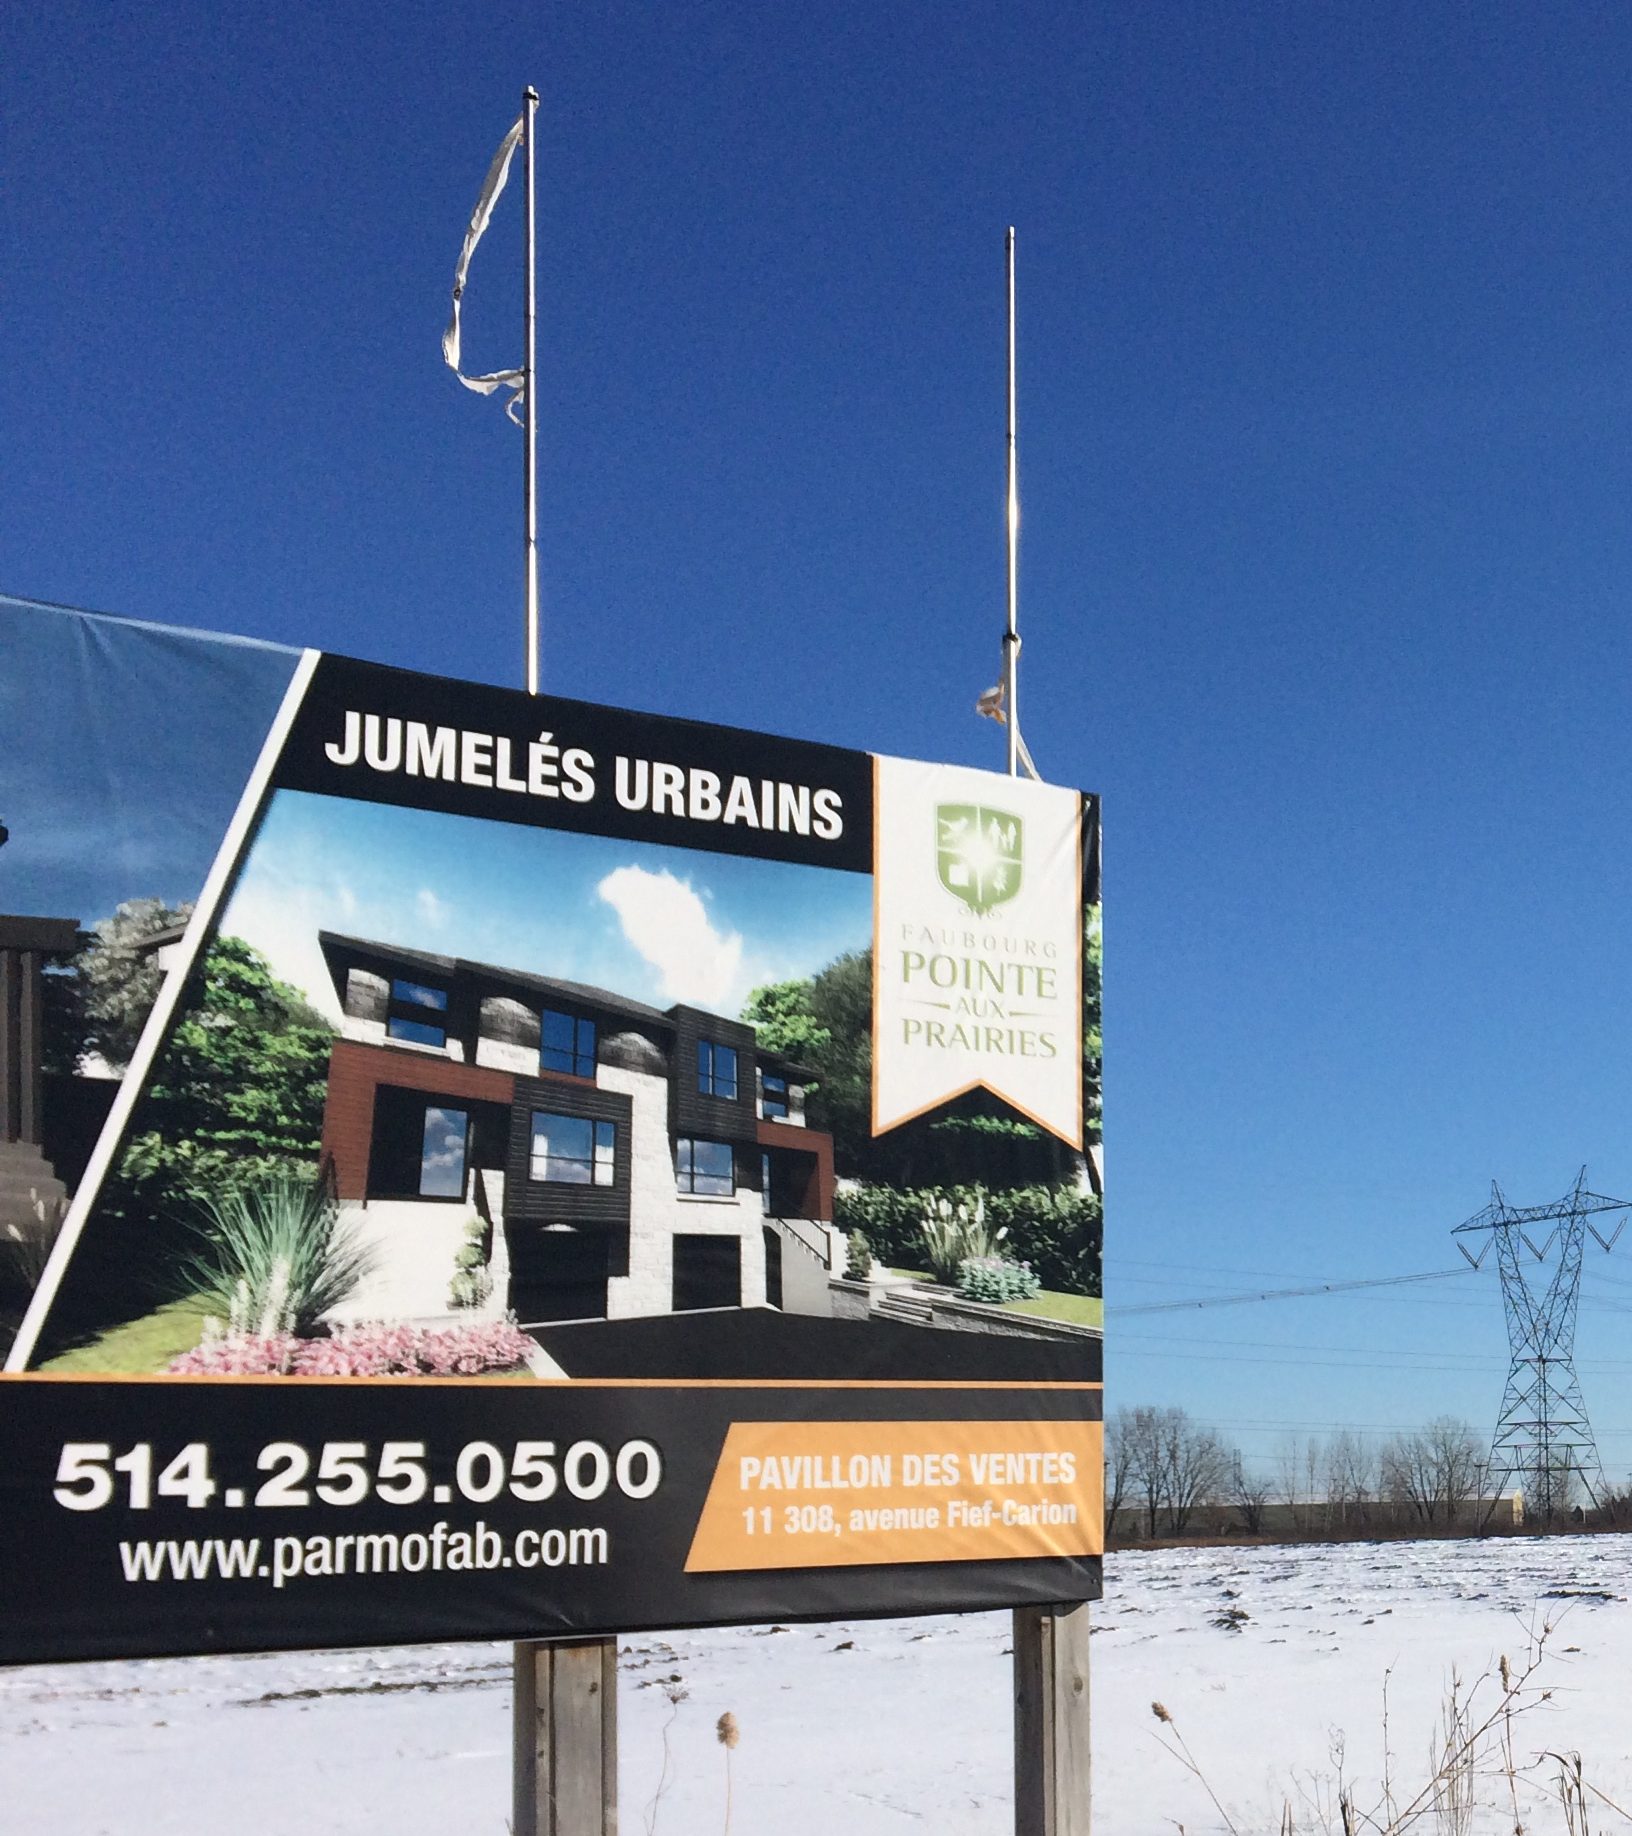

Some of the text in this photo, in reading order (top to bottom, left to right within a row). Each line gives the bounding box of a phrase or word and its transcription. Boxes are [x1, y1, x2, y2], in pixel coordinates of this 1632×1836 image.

[324, 710, 844, 841] JUMELÉS URBAINS
[902, 924, 1057, 958] FAUBOURG
[901, 950, 1058, 1000] POINTE
[955, 995, 1005, 1019] AUX
[901, 1018, 1057, 1059] PRAIRIES
[53, 1439, 663, 1511] 514.255.0500
[739, 1451, 1076, 1491] PAVILLON DES VENTES
[742, 1498, 1077, 1537] 11 308, avenue Fief-Carion
[119, 1521, 608, 1588] www.parmofab.com
